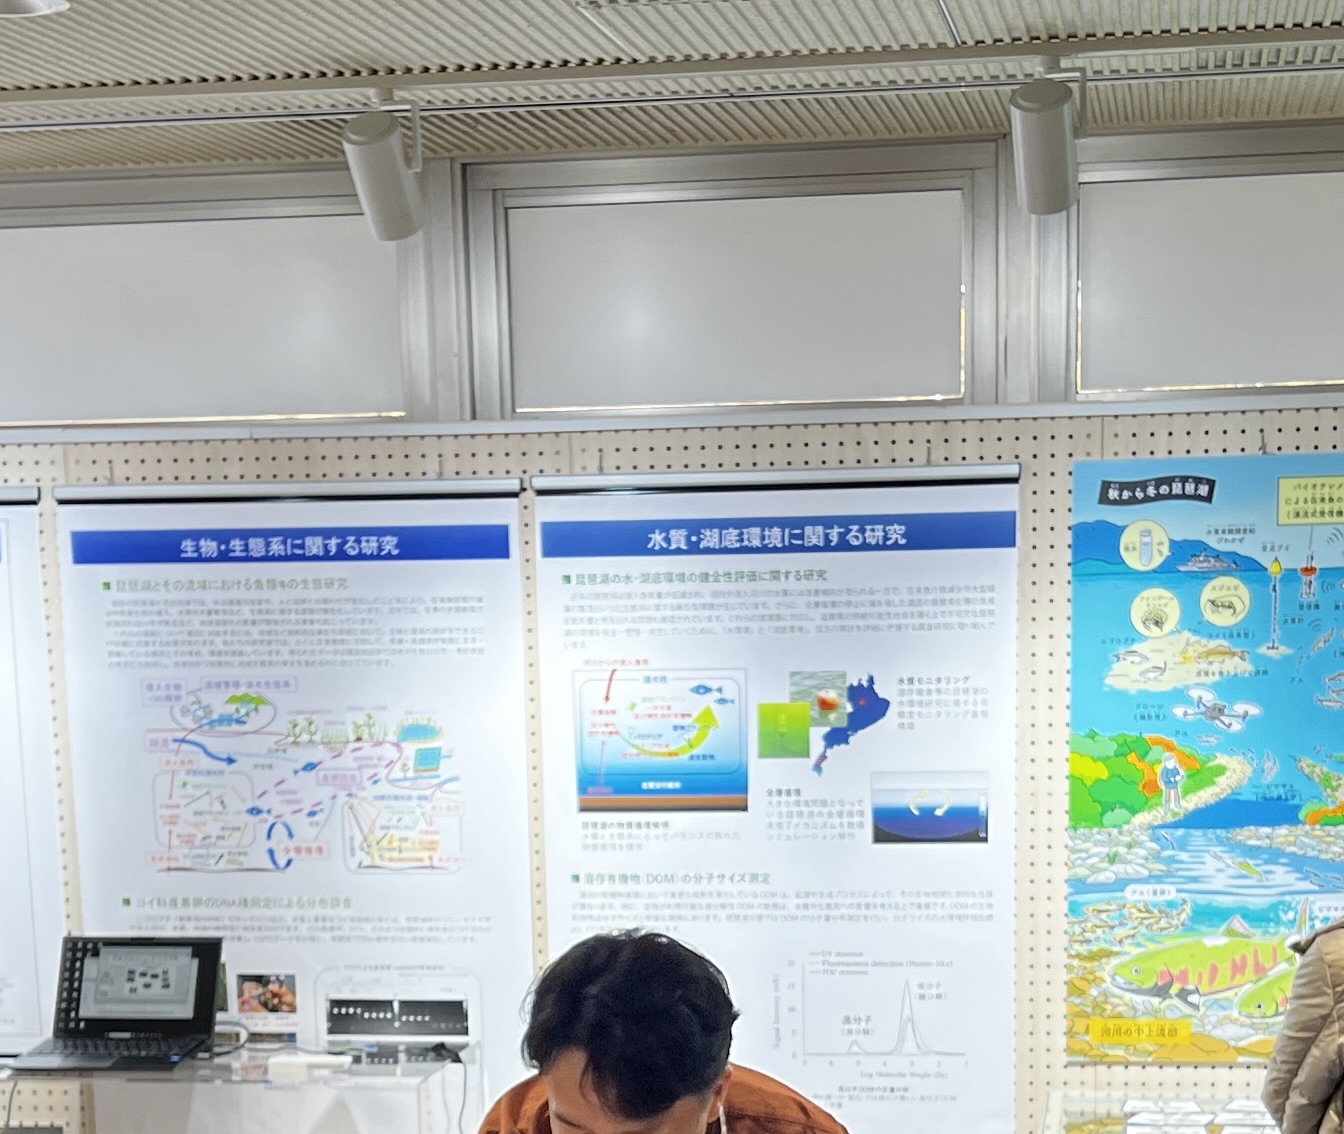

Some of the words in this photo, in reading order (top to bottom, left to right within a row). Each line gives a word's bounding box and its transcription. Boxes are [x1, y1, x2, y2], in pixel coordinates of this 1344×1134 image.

[1107, 482, 1210, 501] 秋から冬の琵琶湖
[180, 535, 399, 559] 生物・生態系に関する研究
[648, 525, 906, 551] 水質・湖底環境に関する研究
